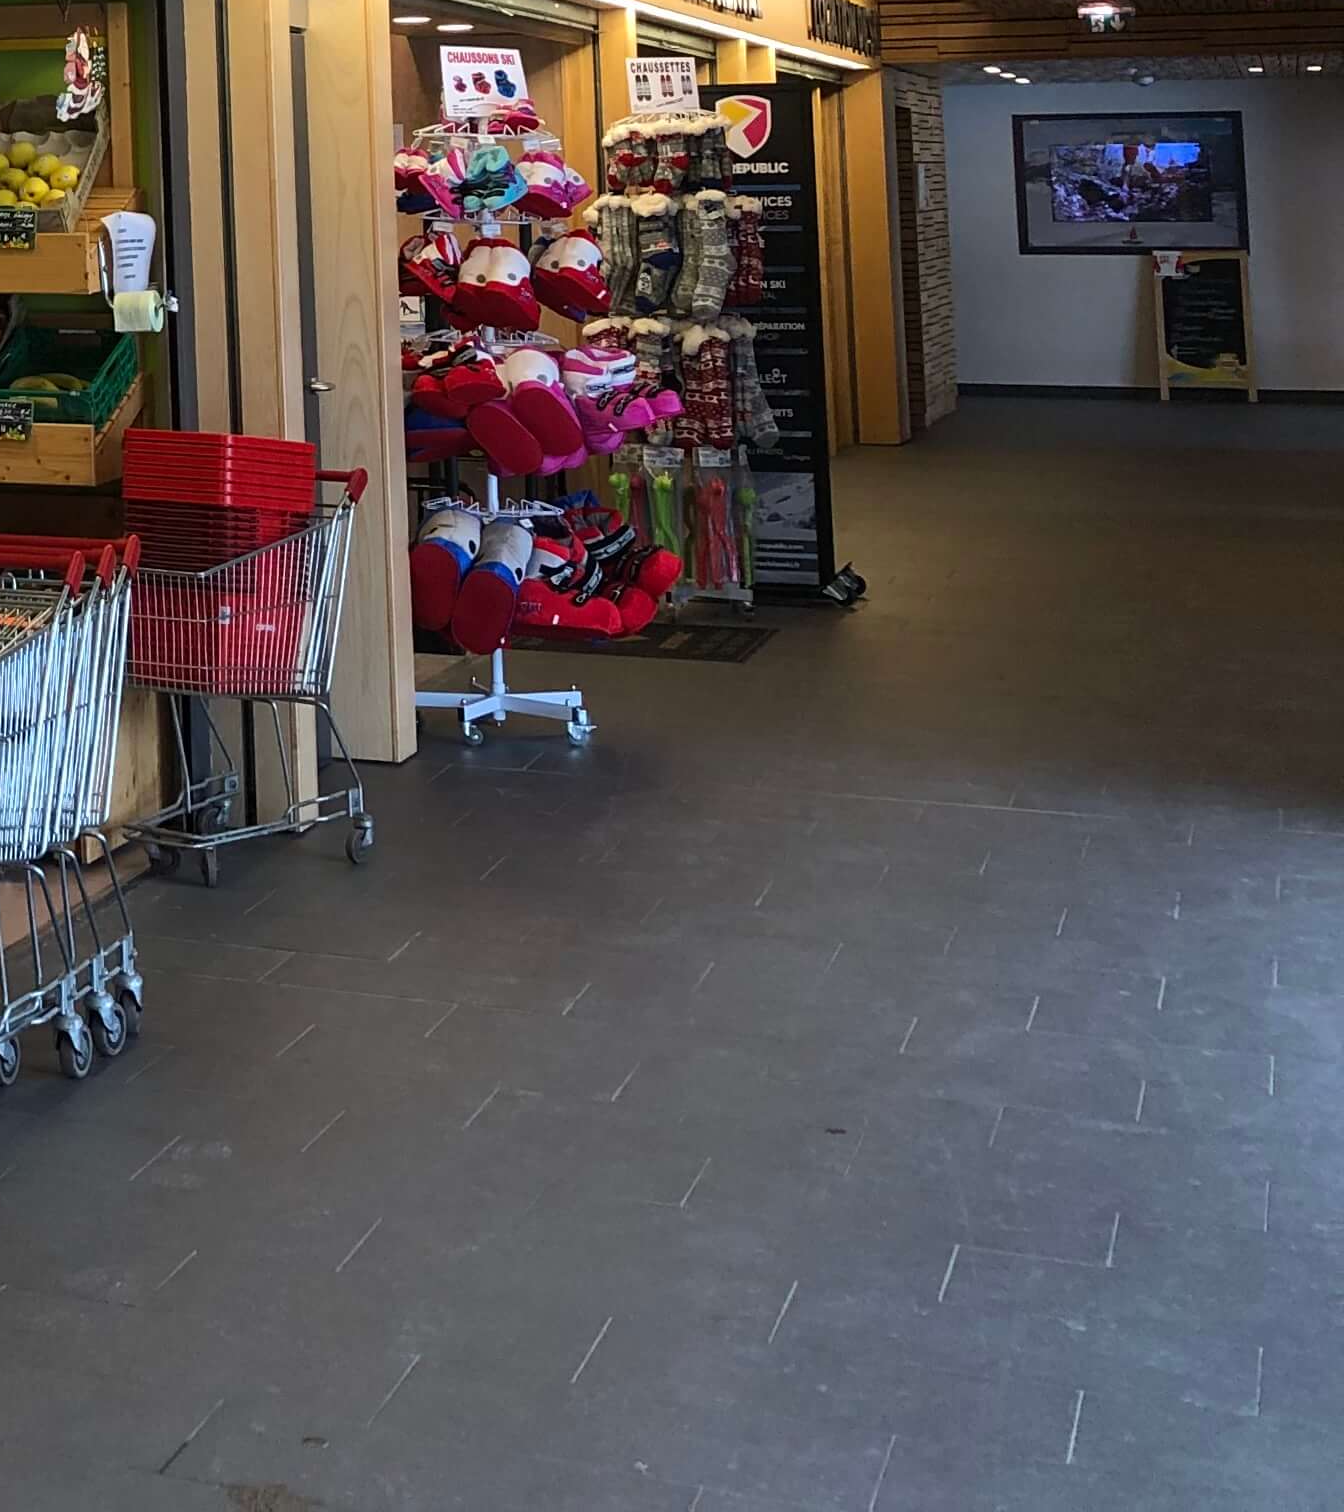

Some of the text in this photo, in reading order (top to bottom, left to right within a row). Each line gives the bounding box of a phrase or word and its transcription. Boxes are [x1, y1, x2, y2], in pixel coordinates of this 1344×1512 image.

[447, 51, 516, 66] CHAUSSONS SKI
[630, 61, 691, 73] CHAUSSETTES
